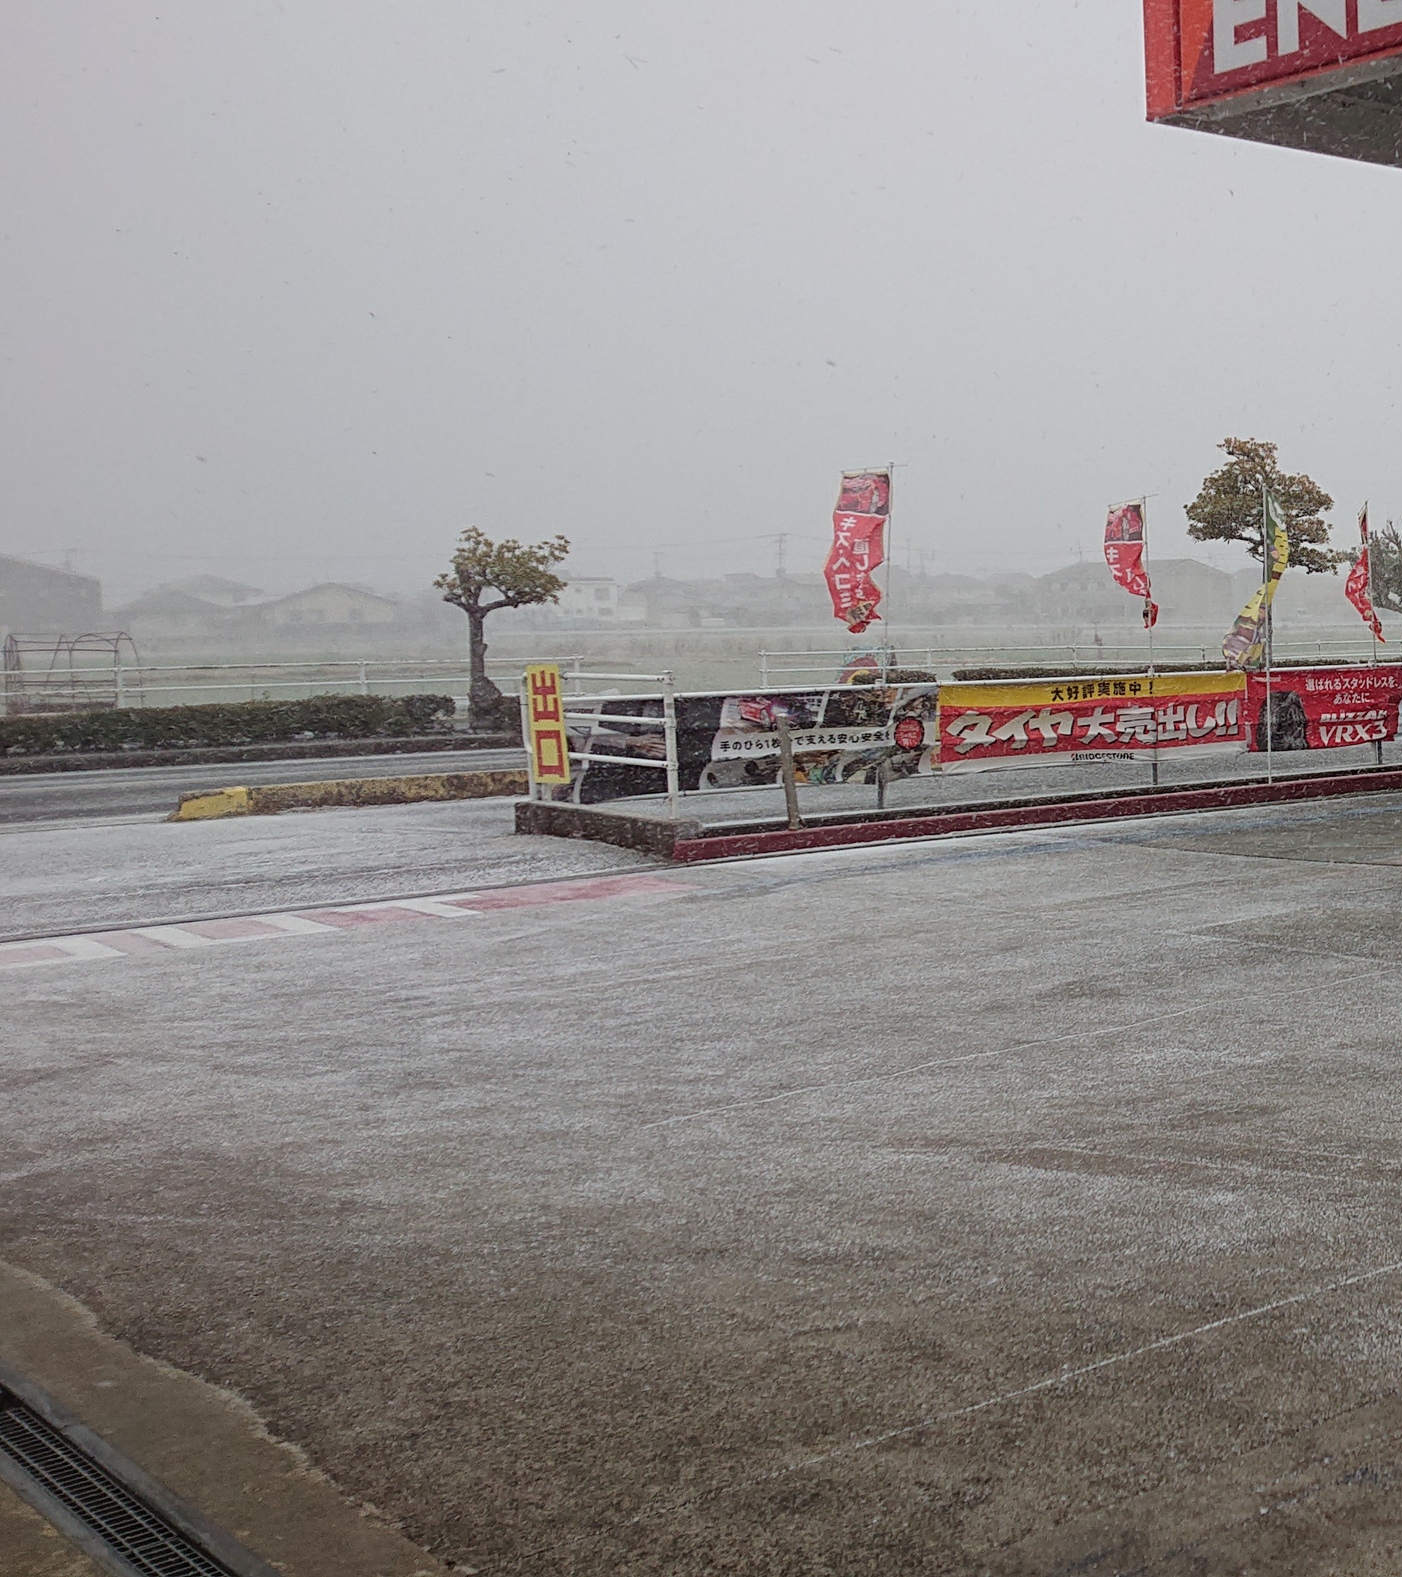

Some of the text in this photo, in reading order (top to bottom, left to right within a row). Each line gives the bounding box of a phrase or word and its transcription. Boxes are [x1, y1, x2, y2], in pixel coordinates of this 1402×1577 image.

[531, 670, 565, 777] 出口
[1319, 720, 1388, 746] VRX3
[720, 731, 890, 752] 手のひら1枚で支える安心安全を
